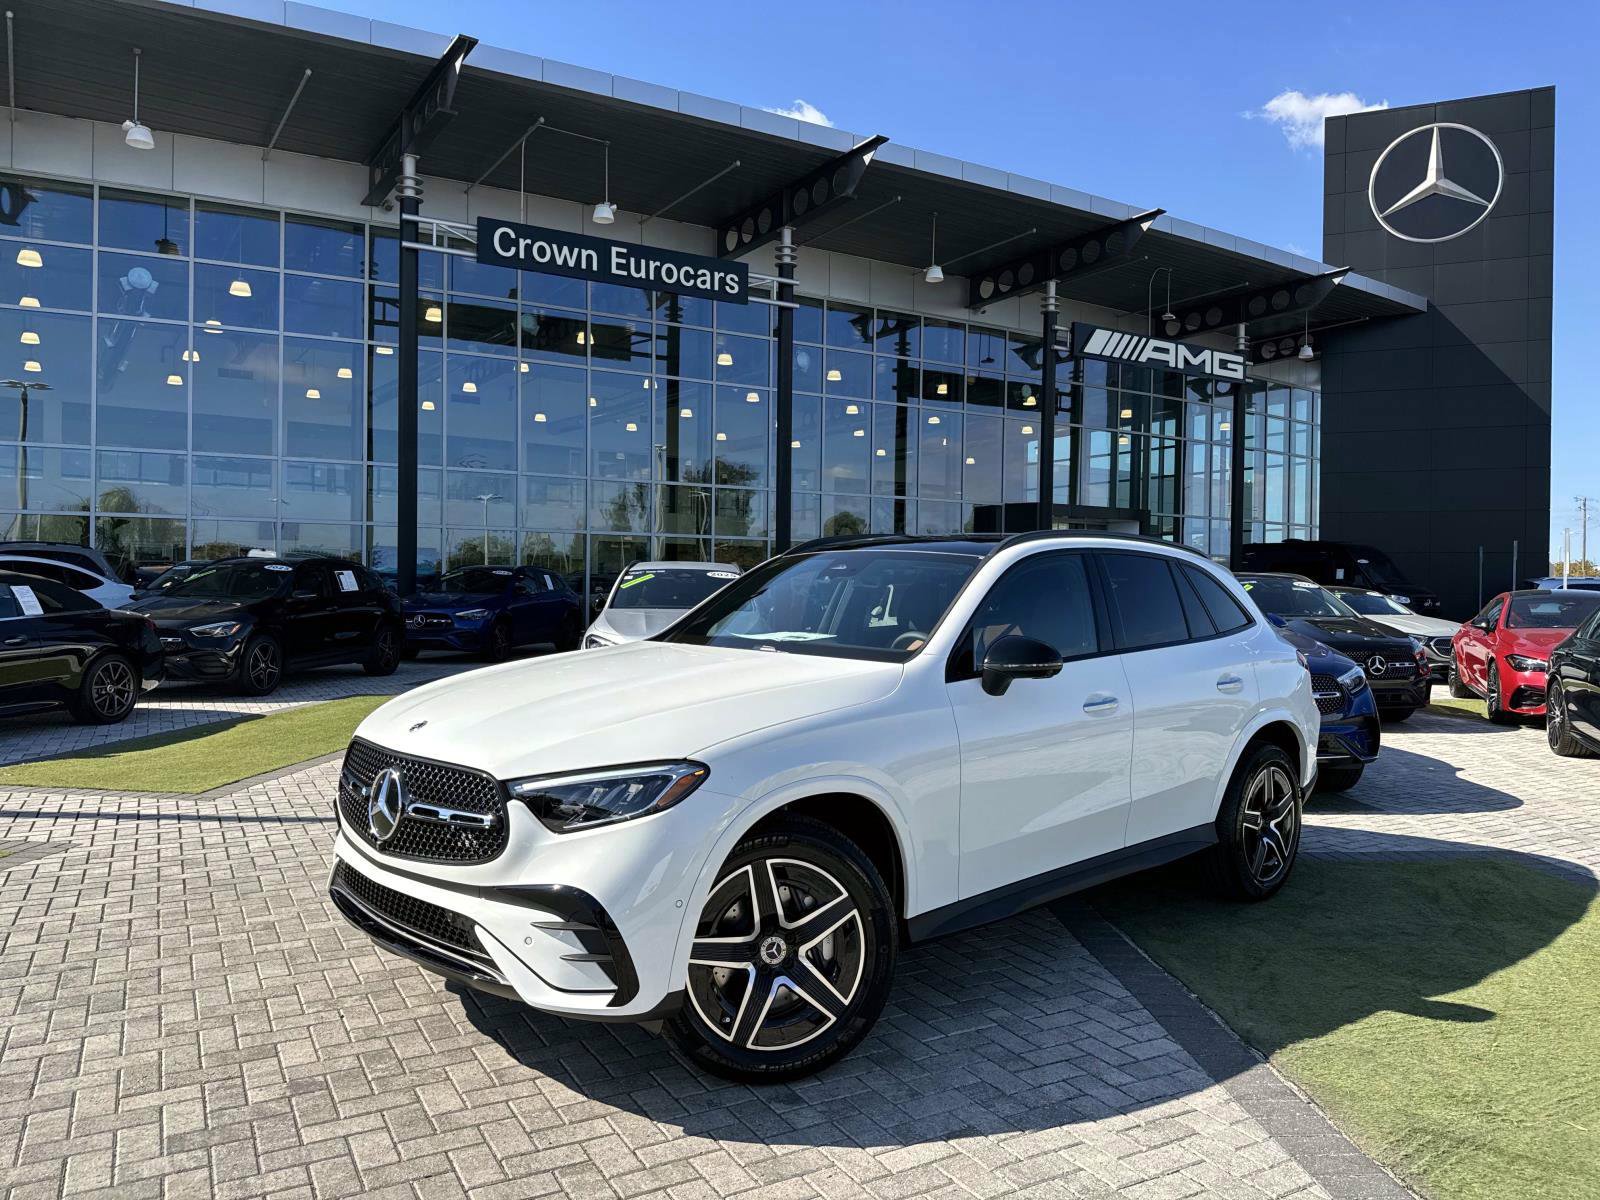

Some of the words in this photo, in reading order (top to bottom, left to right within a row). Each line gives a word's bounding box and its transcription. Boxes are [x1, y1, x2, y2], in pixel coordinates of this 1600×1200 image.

[493, 226, 598, 272] Crown
[611, 246, 739, 295] Eurocars
[1138, 338, 1244, 380] AMG
[734, 836, 789, 854] CHELIN
